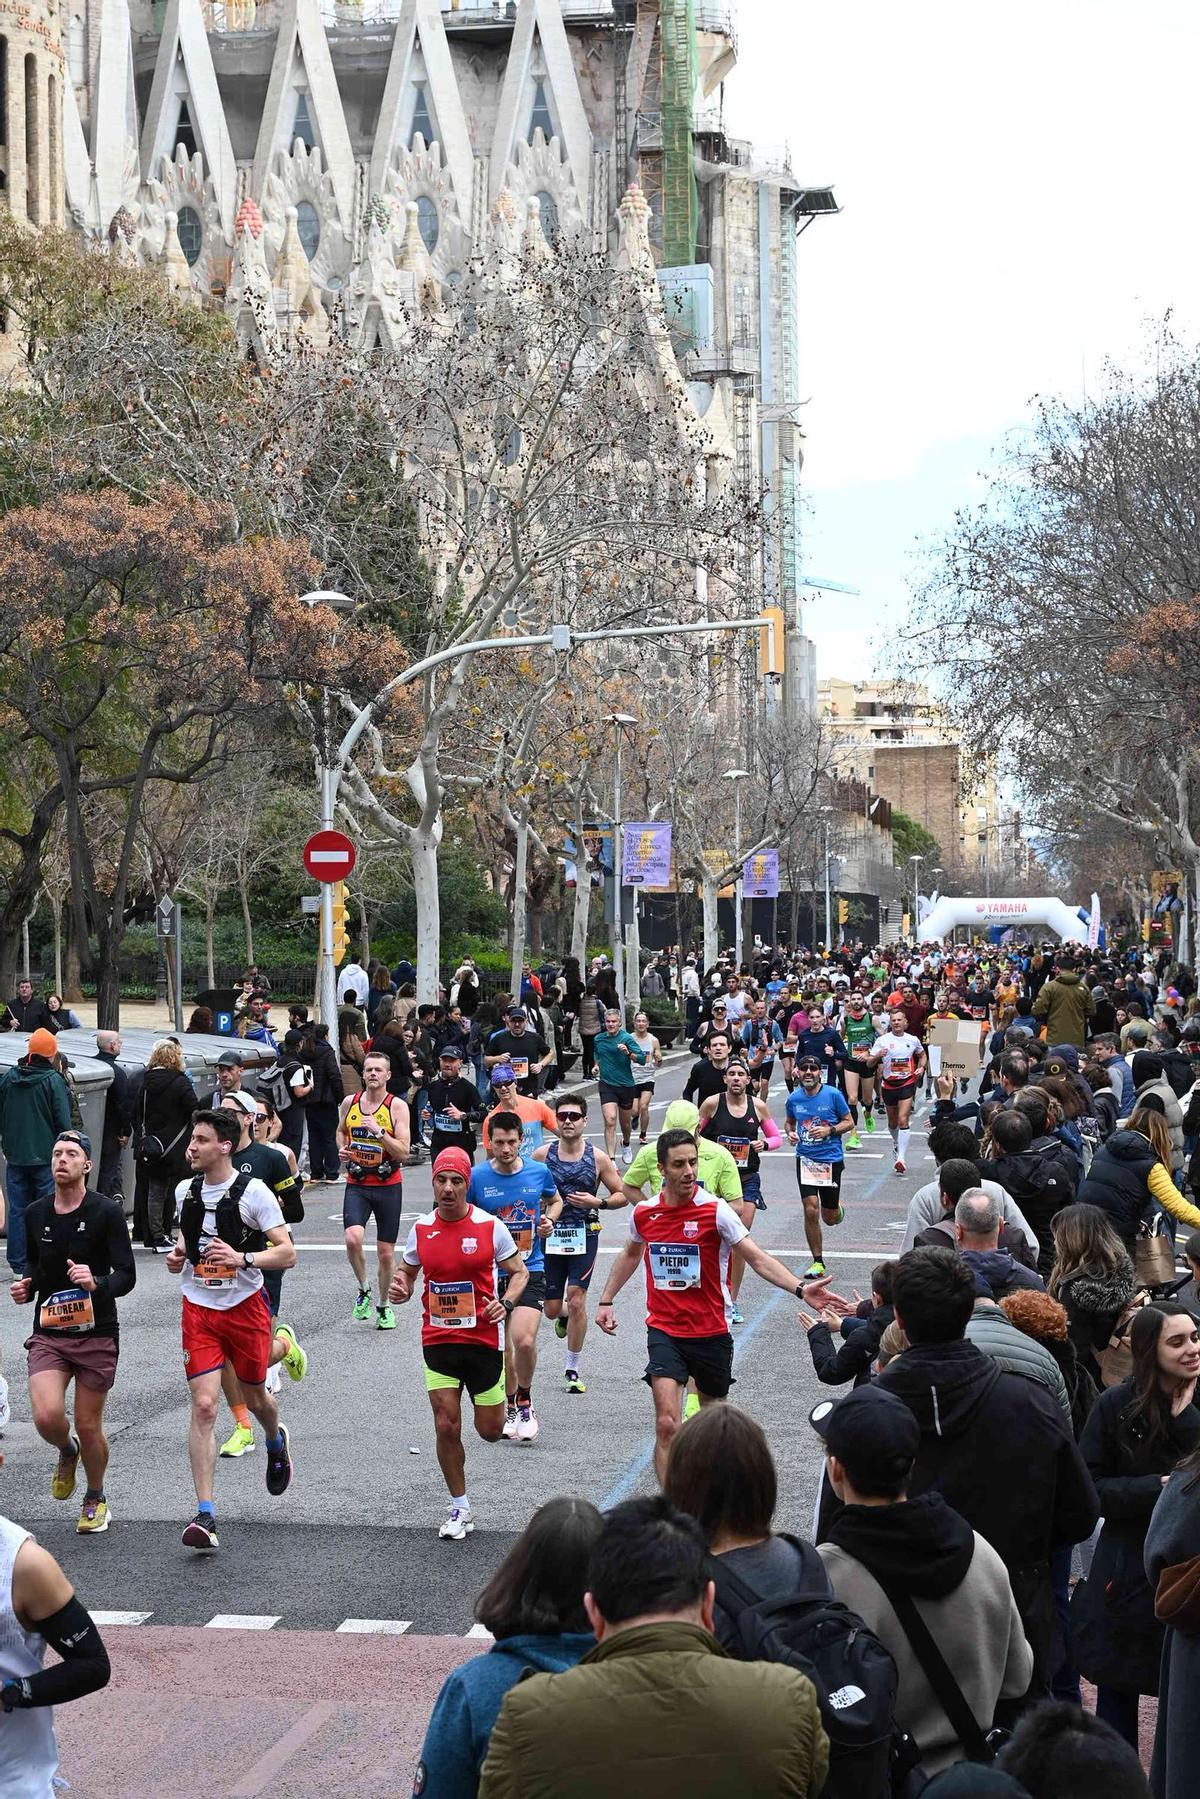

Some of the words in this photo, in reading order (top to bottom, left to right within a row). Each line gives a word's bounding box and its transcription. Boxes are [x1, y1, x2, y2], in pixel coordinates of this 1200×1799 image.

[988, 904, 1028, 913] YAMAHA
[220, 1015, 228, 1029] P
[553, 1229, 579, 1238] SAMUEL
[659, 1256, 689, 1267] PIETRO
[438, 1295, 458, 1306] IVAN
[47, 1301, 86, 1316] FLOREAN
